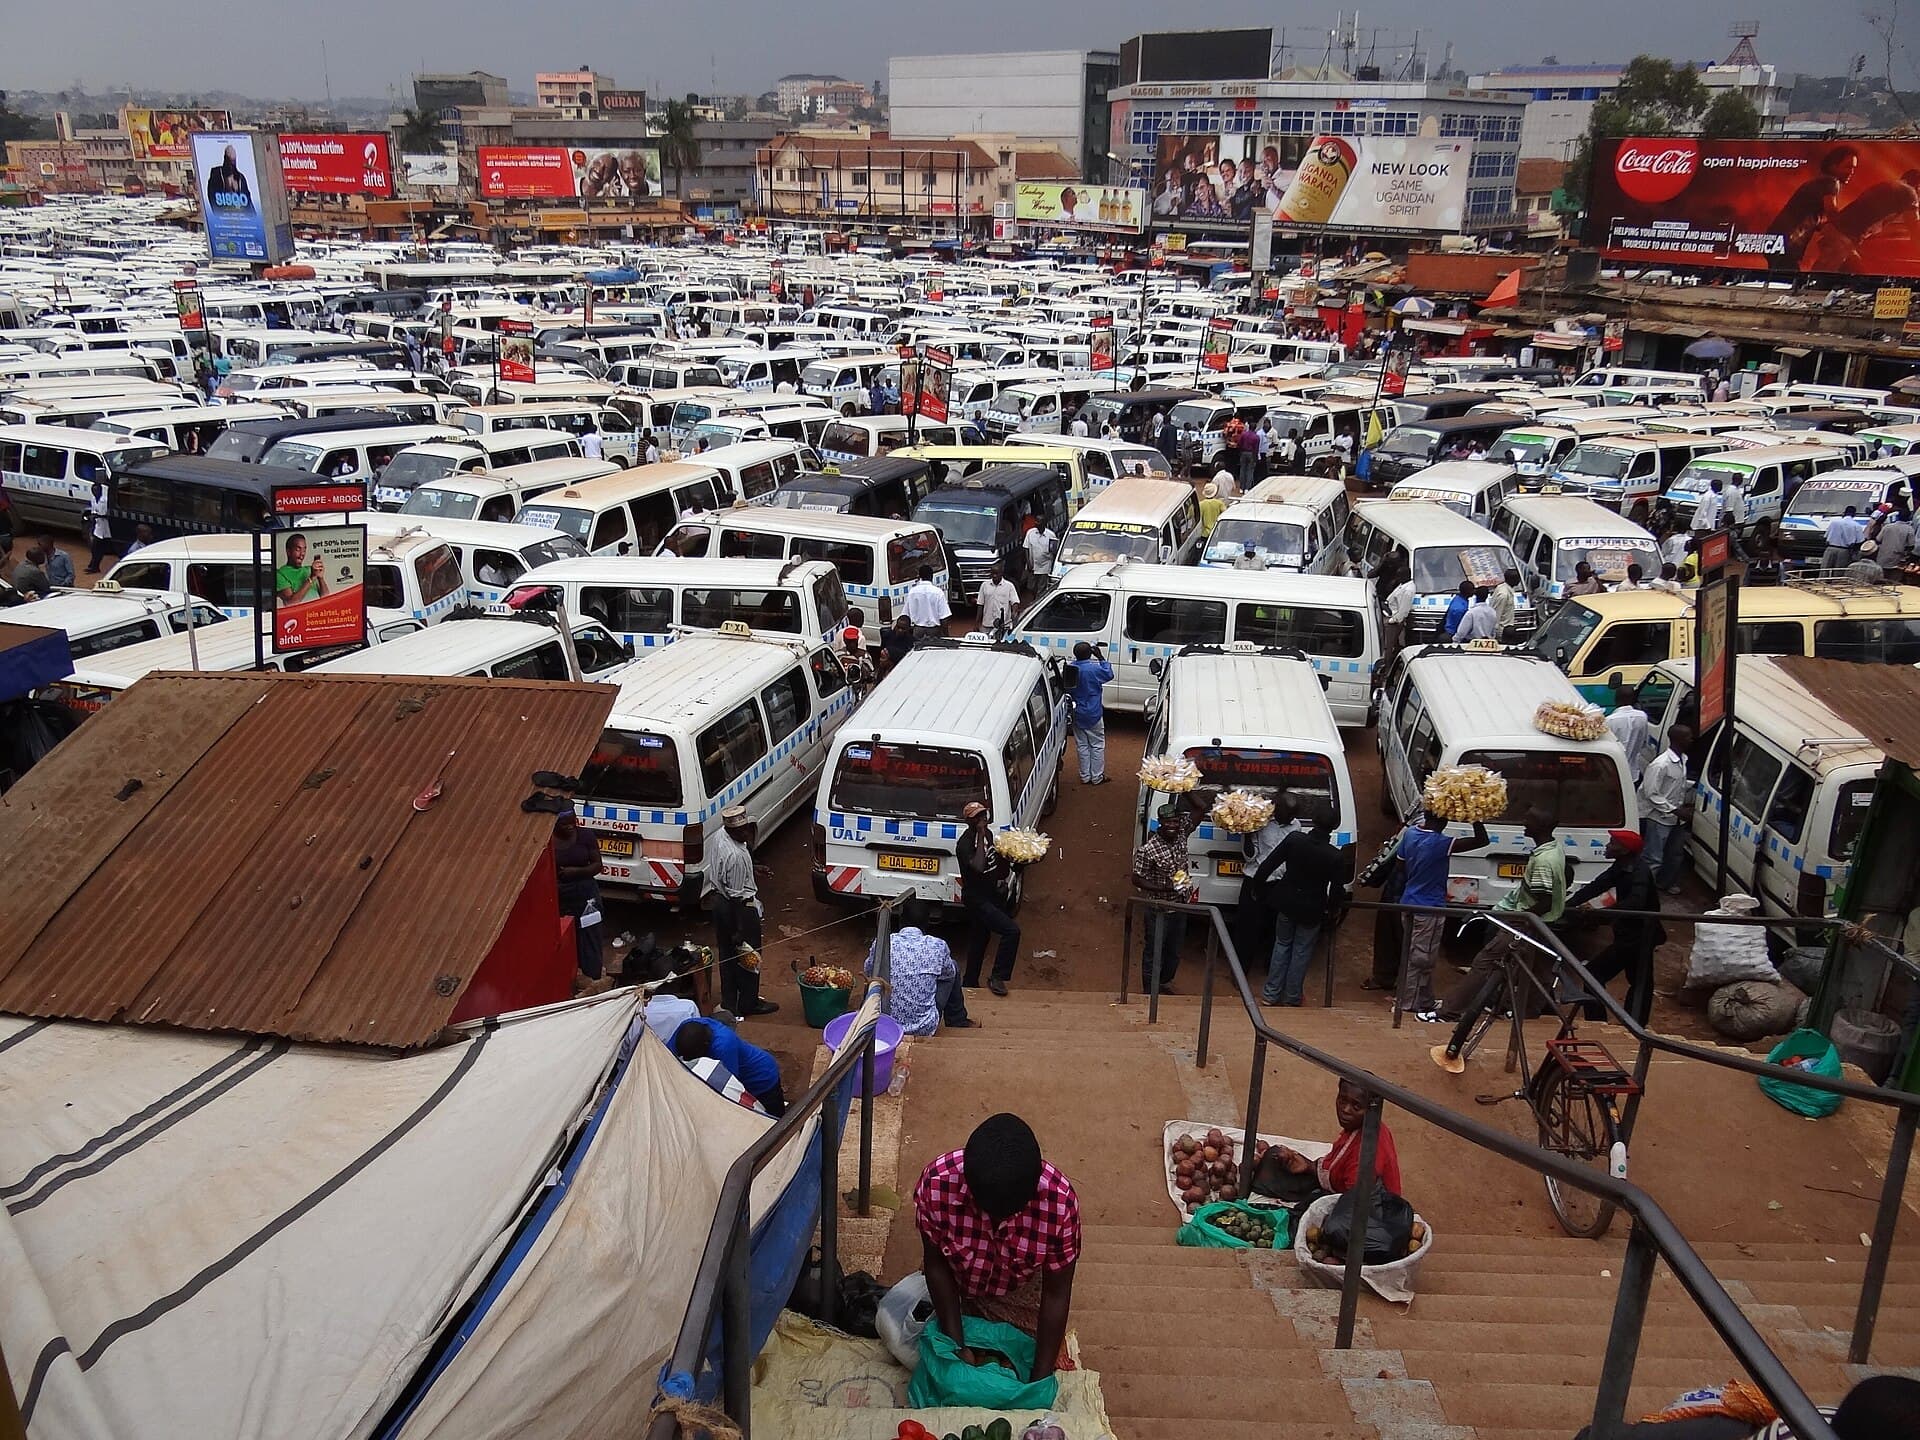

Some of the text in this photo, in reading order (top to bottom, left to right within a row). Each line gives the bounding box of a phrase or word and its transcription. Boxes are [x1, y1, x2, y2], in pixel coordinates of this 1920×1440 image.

[1169, 86, 1213, 96] SHOPPING
[1221, 85, 1257, 96] CENTRE
[603, 95, 641, 109] QURAN
[286, 141, 302, 154] 100%
[302, 142, 321, 154] bonus
[321, 141, 344, 155] airtime
[291, 157, 317, 169] networks
[1618, 148, 1697, 174] Coca-Cola
[1703, 157, 1734, 169] open
[1302, 162, 1338, 189] UGANDA
[1372, 163, 1450, 176] NEW LOOK
[363, 171, 386, 188] airtel
[1298, 172, 1333, 199] WARAGI
[1391, 179, 1423, 191] SAME
[1376, 192, 1435, 204] UGANDAN
[1389, 205, 1421, 216] SPIRIT
[1613, 226, 1727, 242] HELPING YOUR BROTHER AND HELPING
[1622, 240, 1714, 254] YOURSELF TO AN ICE COLD COKE
[283, 495, 327, 505] KAWEMPE
[1075, 521, 1143, 533] ENO MIZANI
[312, 541, 323, 549] get
[323, 539, 339, 547] 50%
[306, 611, 319, 619] join
[341, 608, 351, 616] get
[489, 605, 506, 613] TAXI
[306, 617, 326, 626] bonus
[724, 622, 745, 632] TXI
[279, 634, 303, 646] airtel
[1473, 639, 1496, 649] TAXI
[612, 822, 638, 831] 640T
[832, 828, 866, 841] UAL
[608, 841, 631, 852] 640T
[889, 857, 906, 868] UAL
